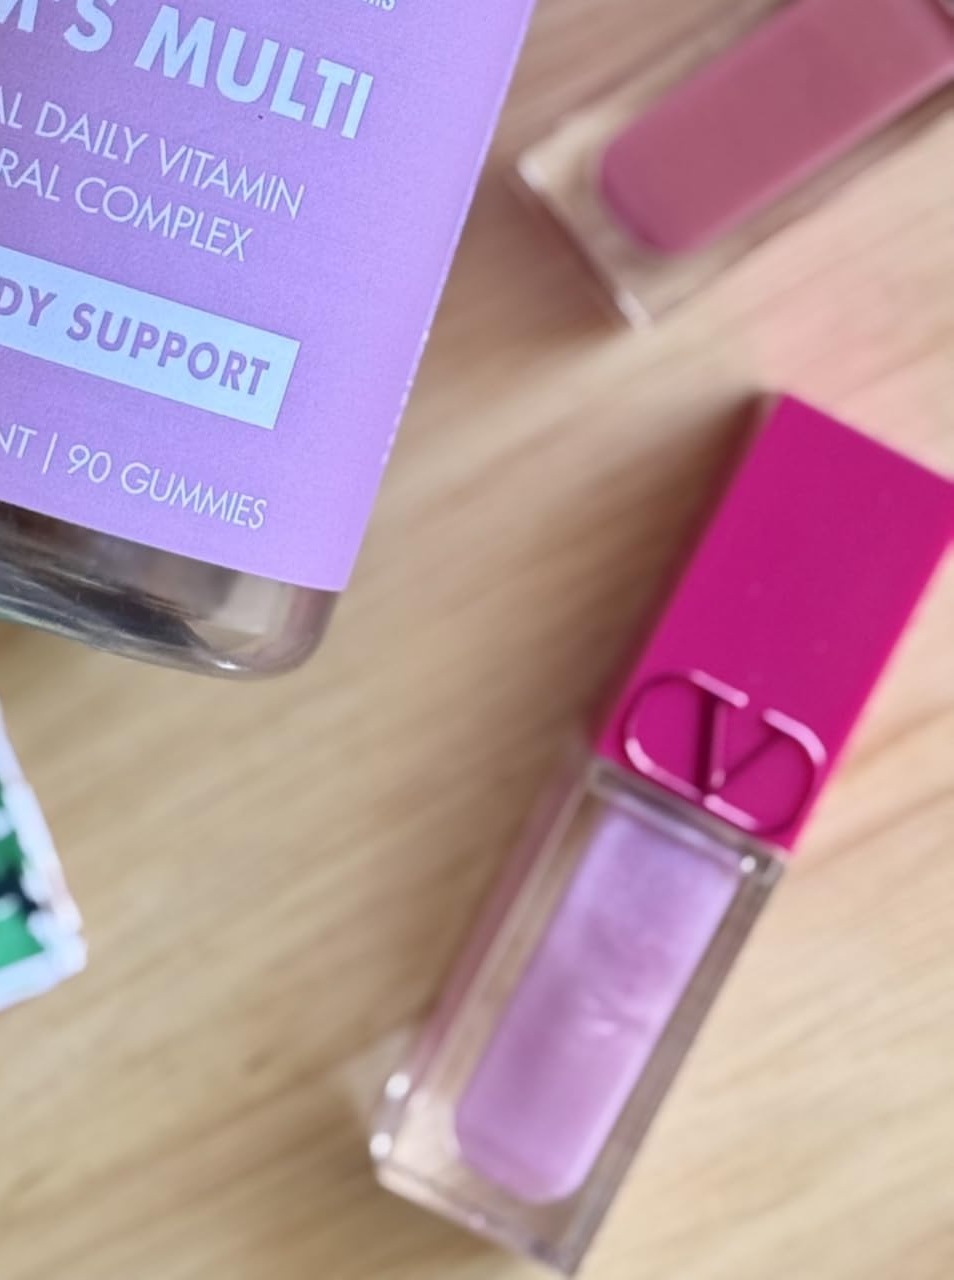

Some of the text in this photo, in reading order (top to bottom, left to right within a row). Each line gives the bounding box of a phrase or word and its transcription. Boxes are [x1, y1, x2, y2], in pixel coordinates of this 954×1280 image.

[135, 4, 374, 139] MULTI
[35, 101, 149, 165] DAILY
[157, 137, 305, 220] VITAMIN
[75, 176, 253, 262] COMPLEX
[66, 302, 270, 397] SUPPORT
[68, 445, 112, 484] 90
[121, 462, 267, 530] GUMMIES
